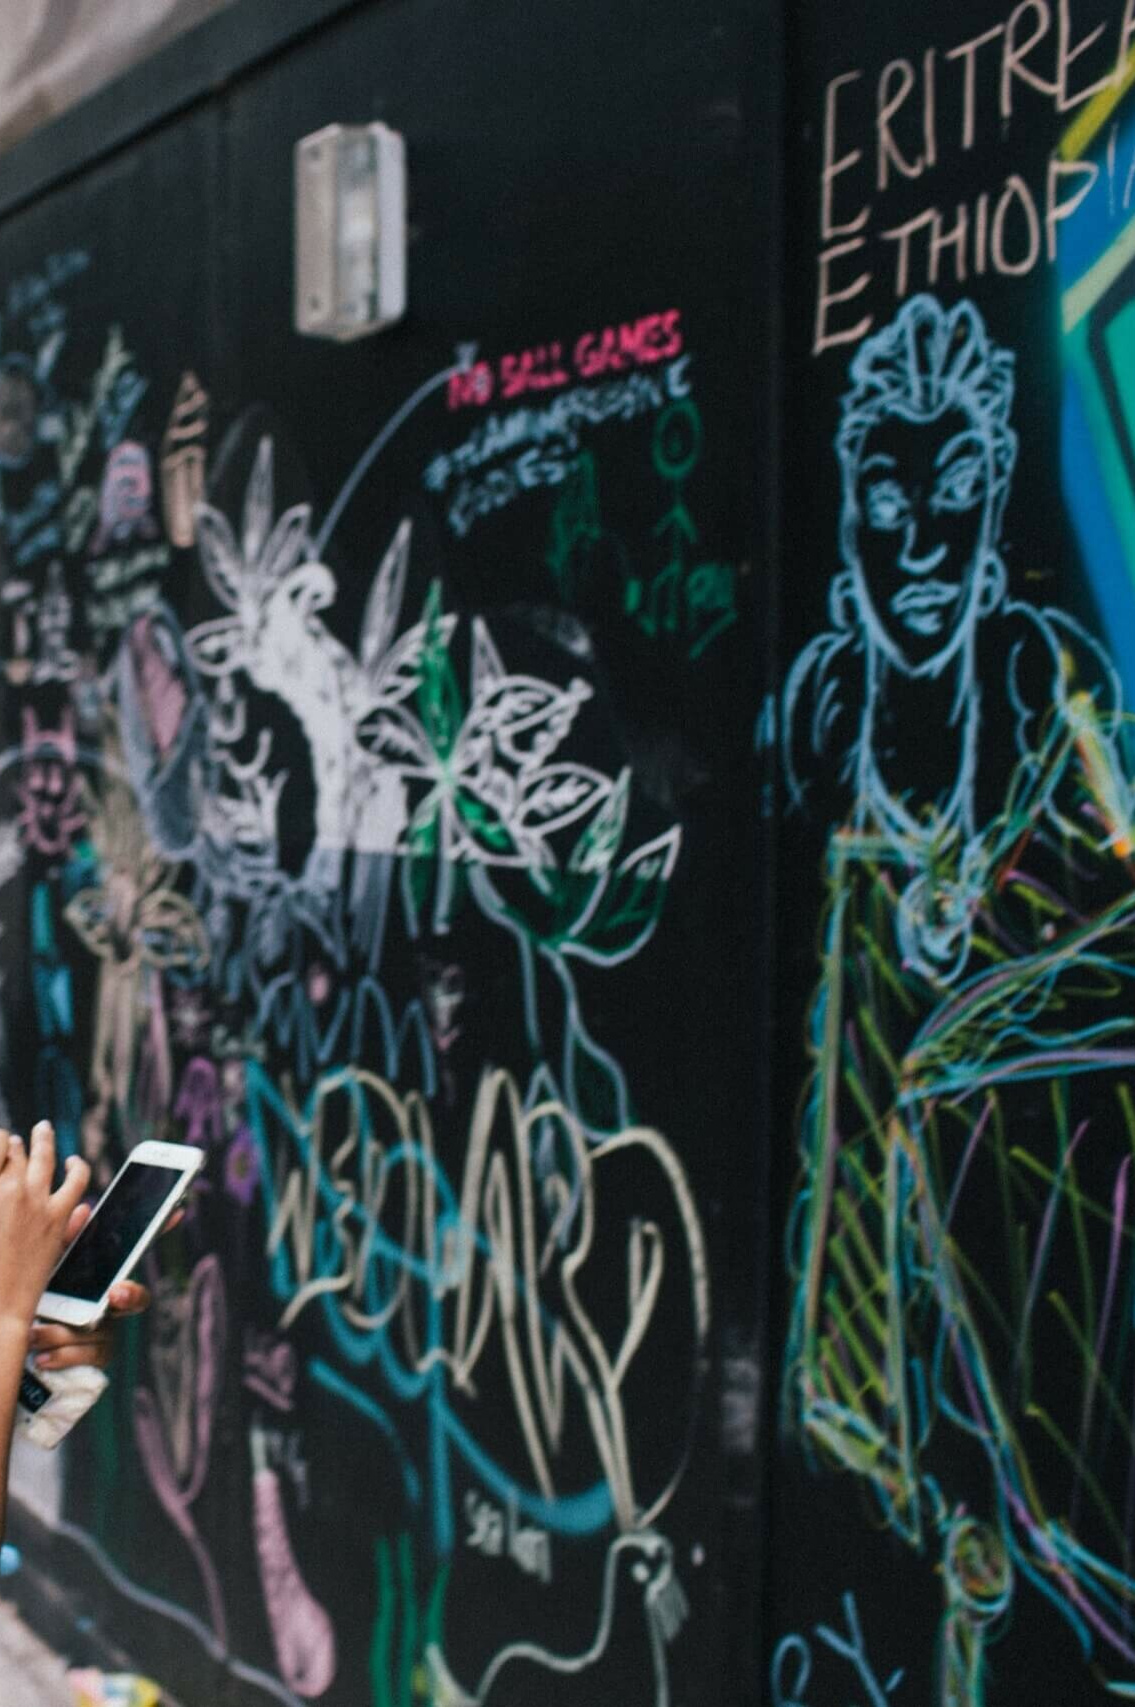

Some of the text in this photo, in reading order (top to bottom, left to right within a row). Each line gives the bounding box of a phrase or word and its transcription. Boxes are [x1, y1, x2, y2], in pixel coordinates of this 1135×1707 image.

[448, 307, 682, 409] NO BALL GAMES
